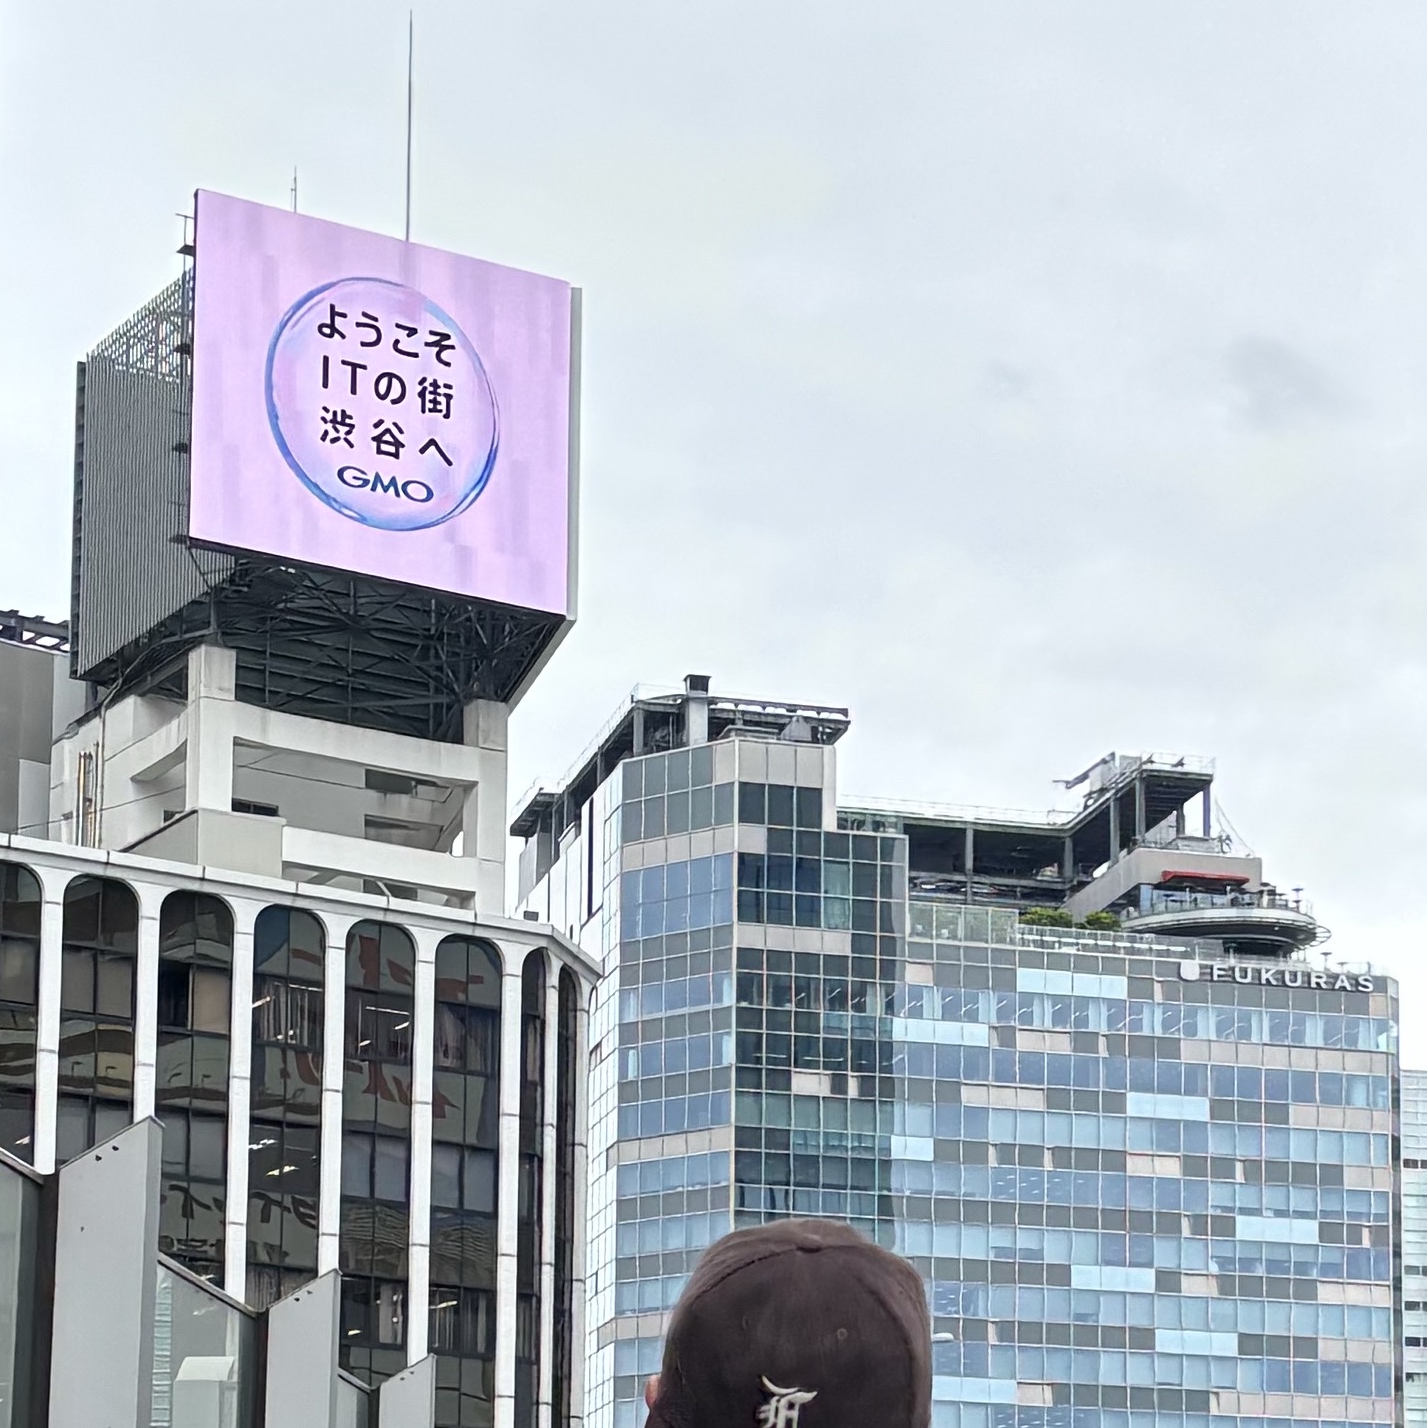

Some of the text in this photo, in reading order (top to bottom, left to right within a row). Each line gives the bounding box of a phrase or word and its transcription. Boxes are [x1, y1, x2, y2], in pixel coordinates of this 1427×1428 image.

[317, 303, 456, 367] ようこそ
[322, 354, 454, 419] ITの街
[320, 406, 453, 467] 渋谷へ
[336, 465, 434, 503] GMO
[1212, 964, 1374, 992] FUKURAS
